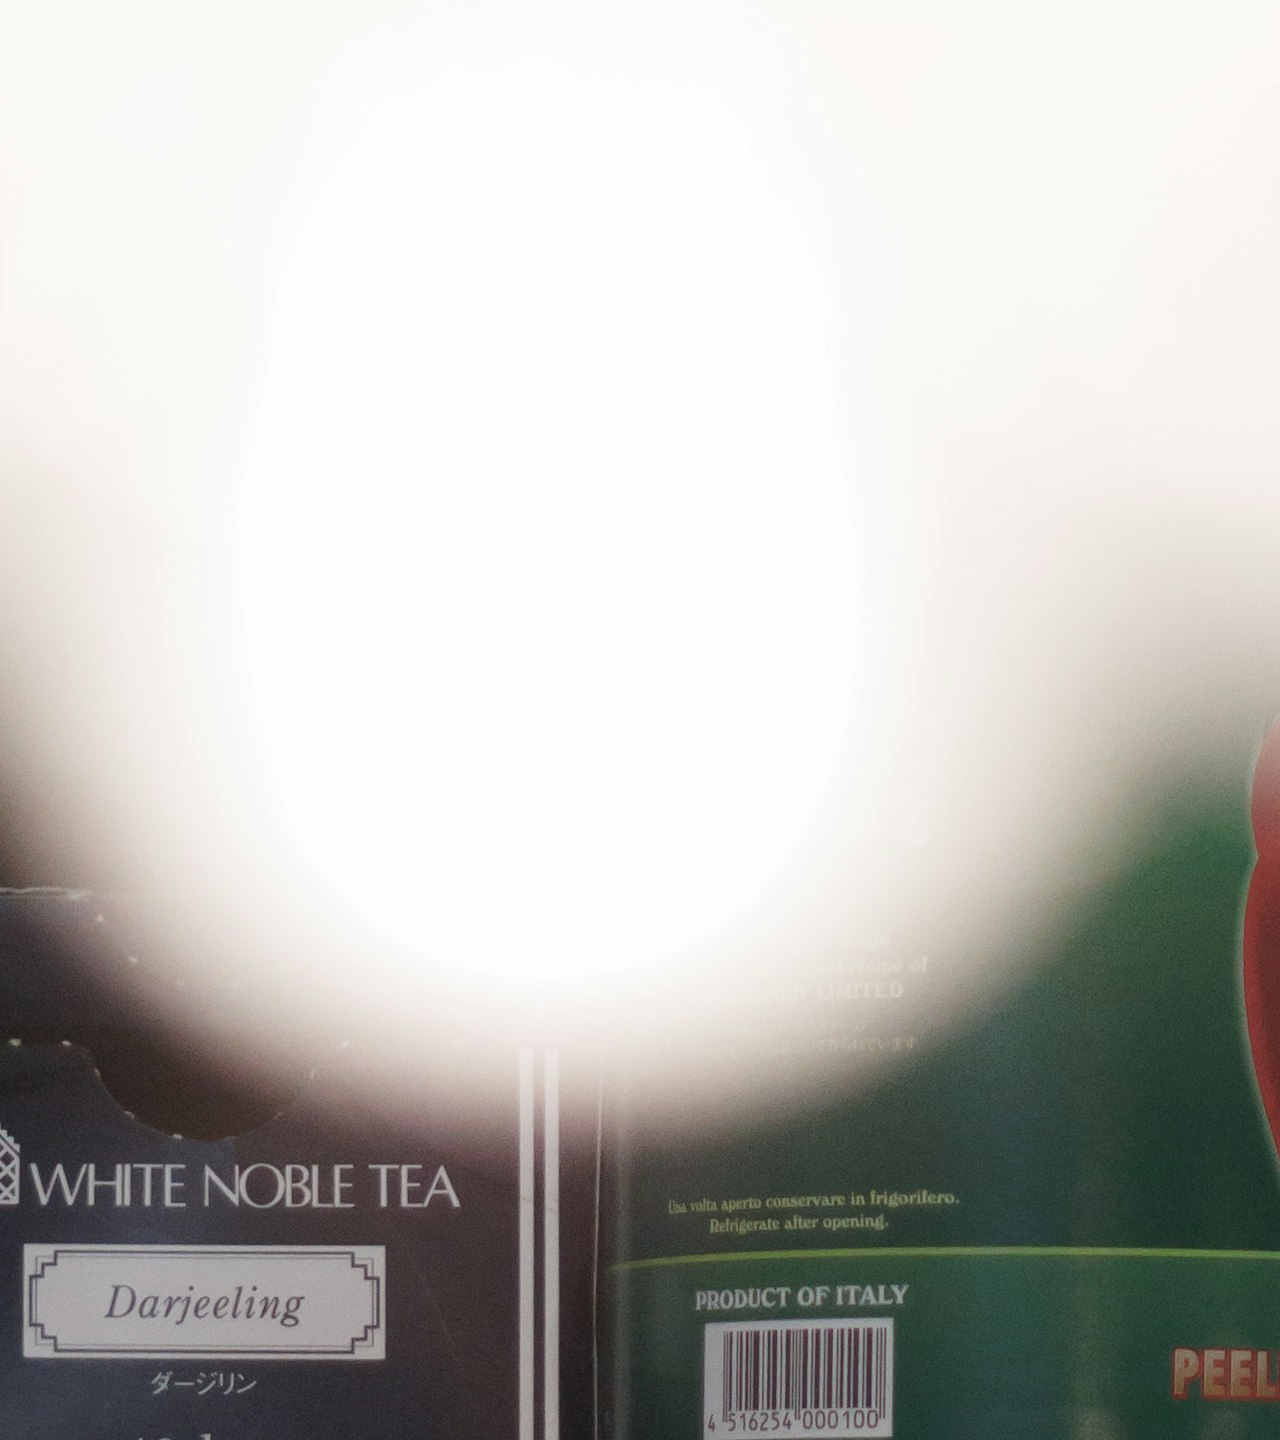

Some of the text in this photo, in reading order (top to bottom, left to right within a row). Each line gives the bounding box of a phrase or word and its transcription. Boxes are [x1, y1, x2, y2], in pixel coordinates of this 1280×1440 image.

[29, 1162, 462, 1210] WHITE NOBLE TEA
[721, 1195, 762, 1213] aperto
[765, 1191, 846, 1210] conservare
[850, 1189, 866, 1206] in
[869, 1187, 961, 1208] frigorifero.
[709, 1213, 890, 1235] Refrigerate after opening.
[104, 1284, 306, 1328] Darjeeling
[694, 1284, 910, 1311] PRODUCT OF ITALY
[151, 1371, 258, 1396] ダージリン
[727, 1411, 793, 1432] 516254
[801, 1409, 880, 1430] 000100
